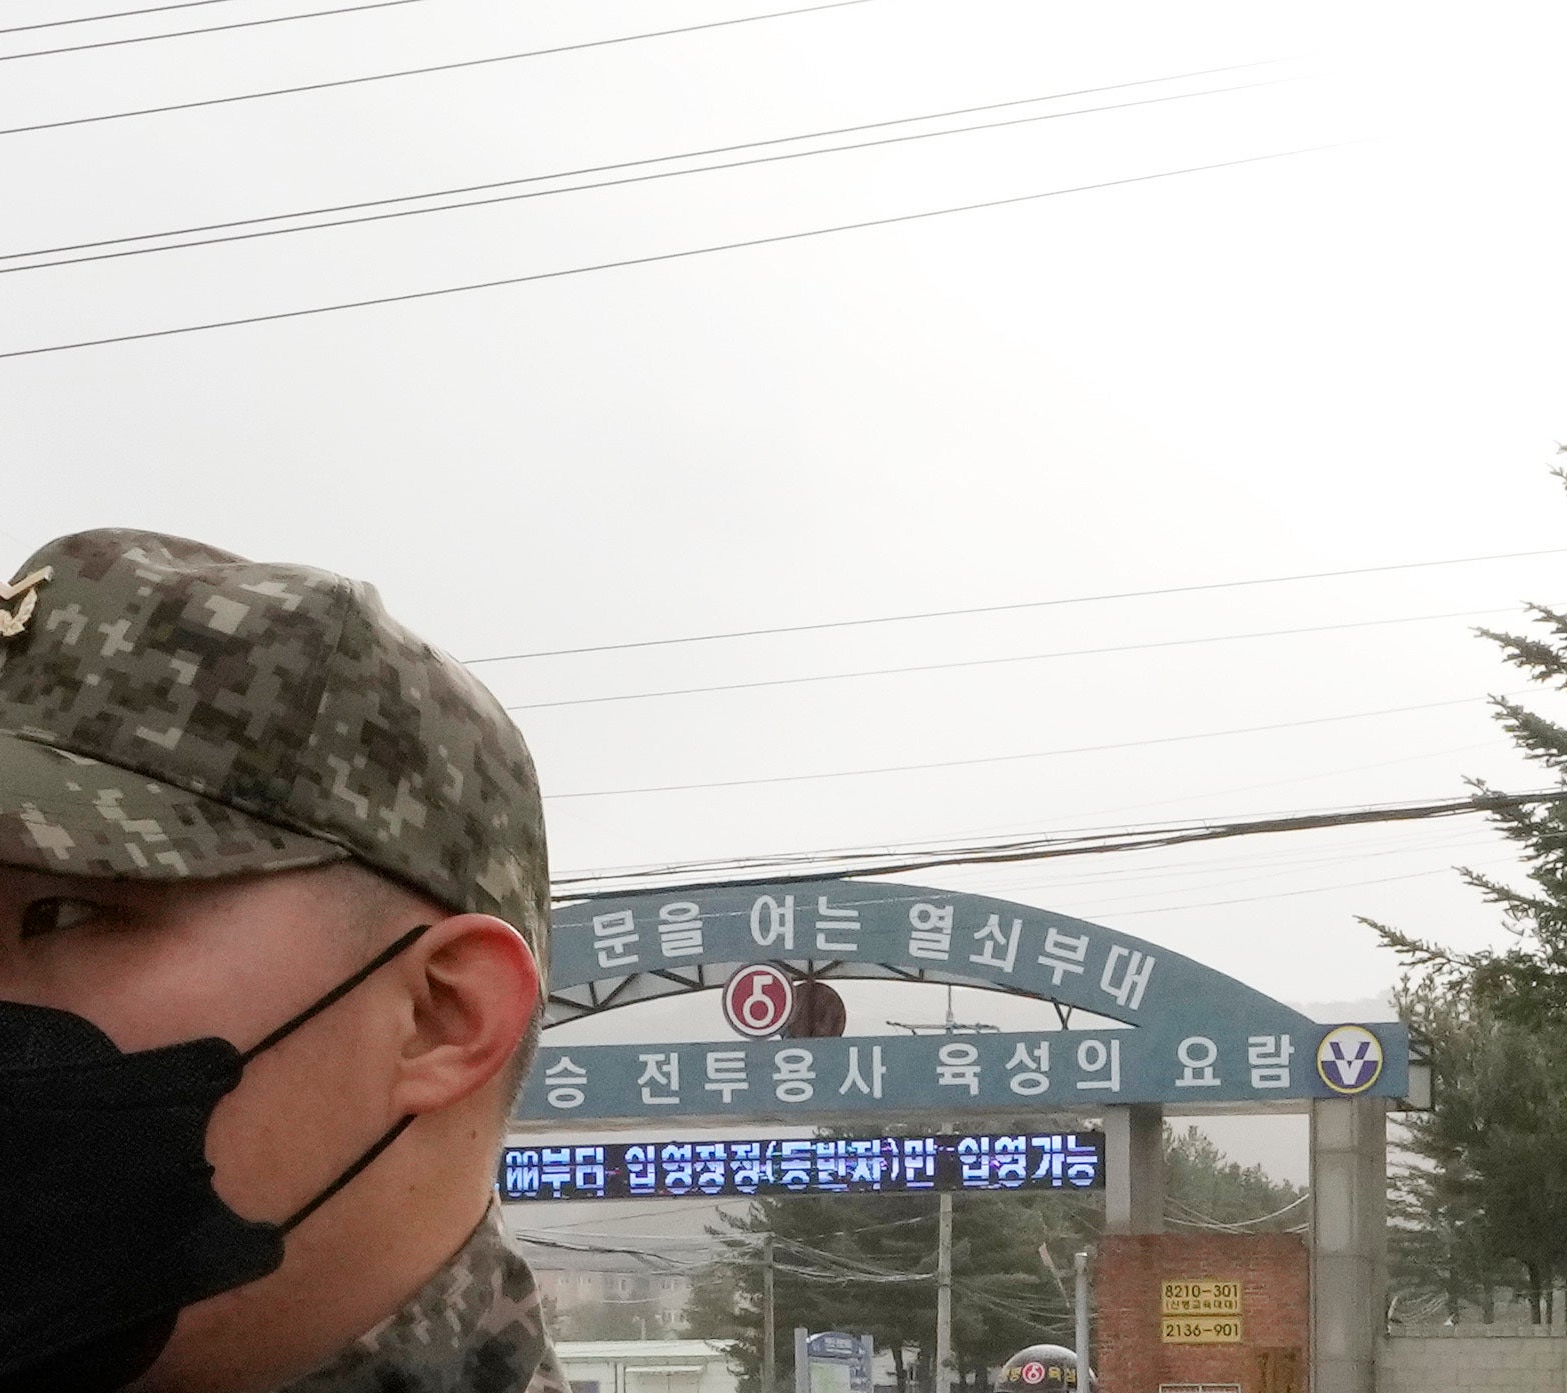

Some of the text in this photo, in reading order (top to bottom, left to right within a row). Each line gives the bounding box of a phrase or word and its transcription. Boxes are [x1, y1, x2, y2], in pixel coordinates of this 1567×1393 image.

[593, 895, 1156, 1011] 문을 여는 열쇠부대
[637, 1046, 886, 1104] 전투용사
[936, 1038, 1120, 1096] 육성의
[1175, 1034, 1294, 1089] 요람
[958, 1134, 1098, 1188] 입영가능
[1165, 1285, 1238, 1298] 8210-301
[1166, 1323, 1239, 1337] 2136-901
